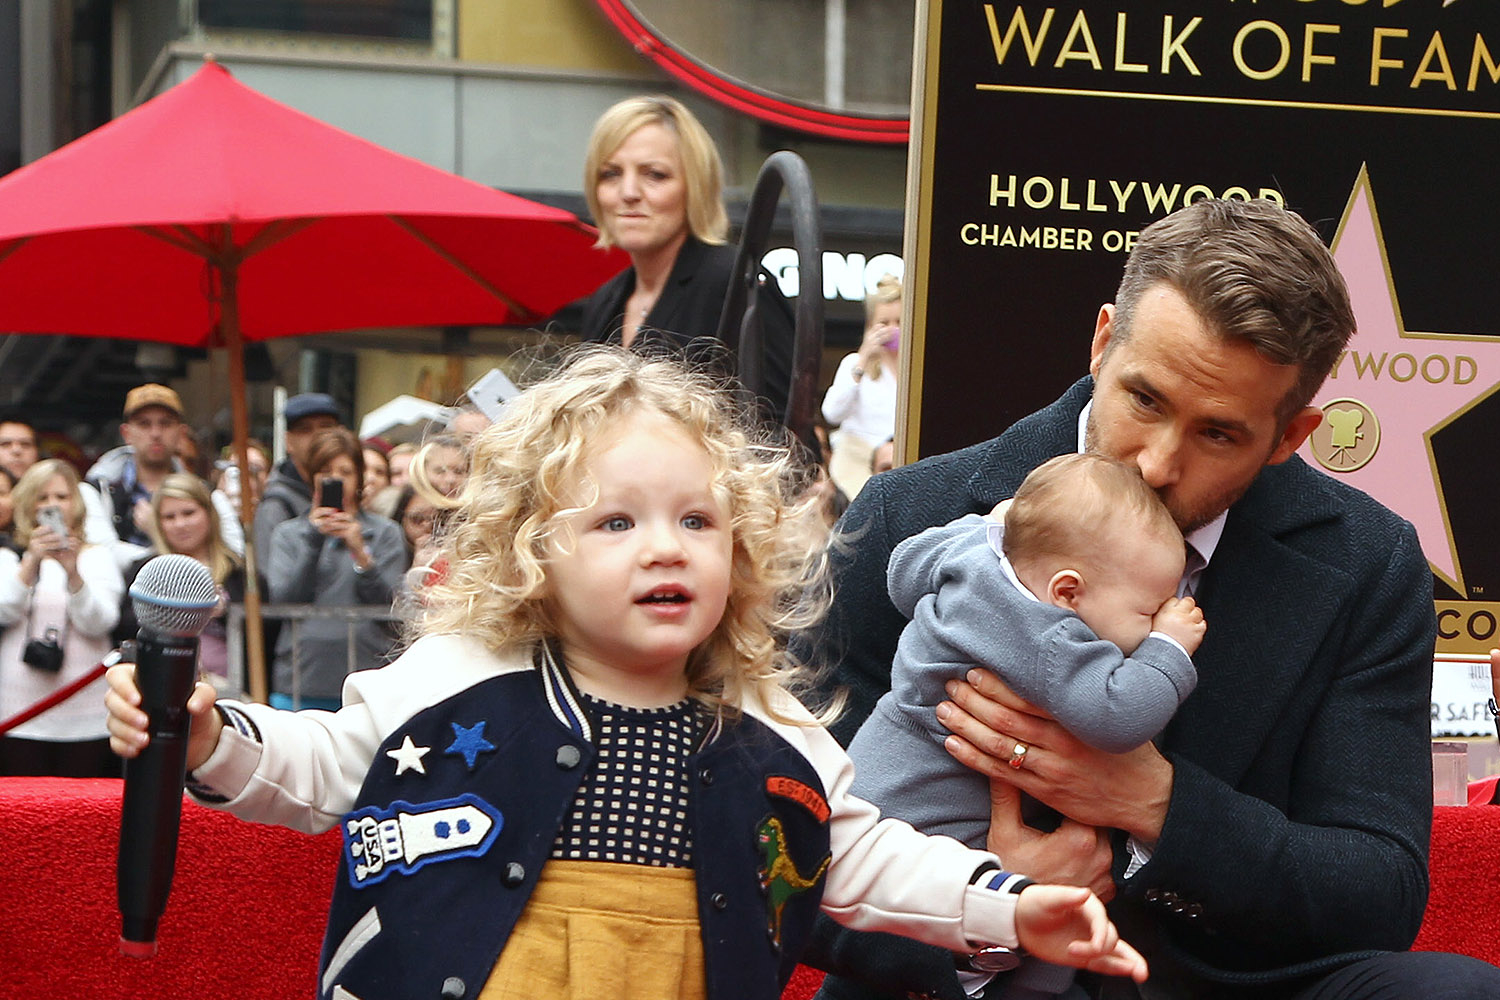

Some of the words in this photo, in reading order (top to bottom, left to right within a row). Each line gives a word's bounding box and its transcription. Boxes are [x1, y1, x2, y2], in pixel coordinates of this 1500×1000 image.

[983, 4, 1203, 76] WALK
[1232, 19, 1341, 82] OF
[959, 222, 1094, 252] CHAMBER
[1101, 230, 1141, 254] OF
[363, 825, 382, 867] USA
